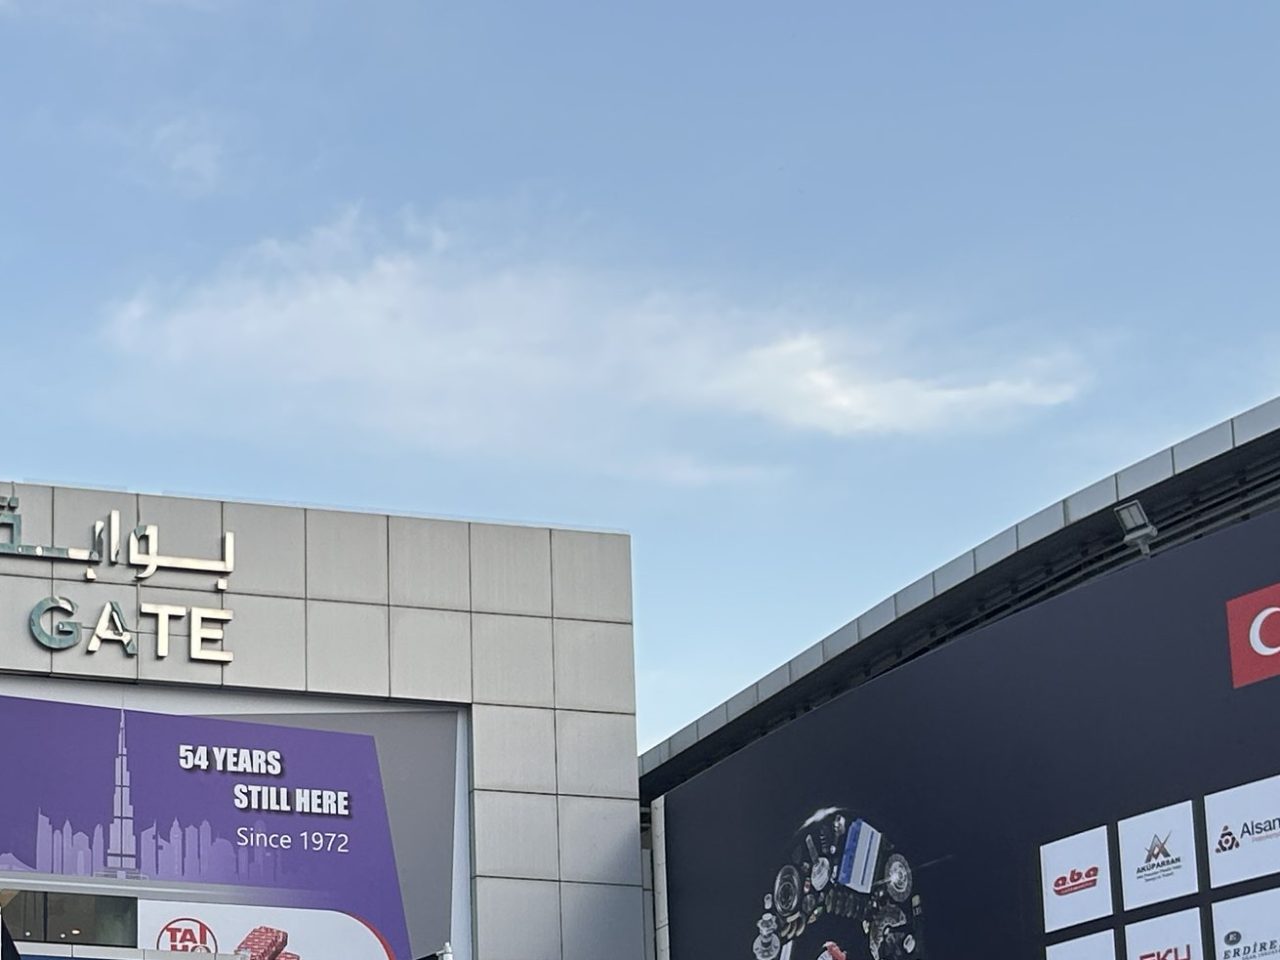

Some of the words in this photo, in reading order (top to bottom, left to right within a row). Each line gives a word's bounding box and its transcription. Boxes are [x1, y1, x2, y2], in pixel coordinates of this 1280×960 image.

[28, 596, 234, 662] GATE
[178, 744, 209, 770] 54
[212, 746, 282, 775] YEARS
[233, 783, 291, 812] STILL
[295, 788, 350, 816] HERE
[236, 827, 292, 849] Since
[299, 831, 350, 853] 1972
[1223, 938, 1280, 960] ERDİRE
